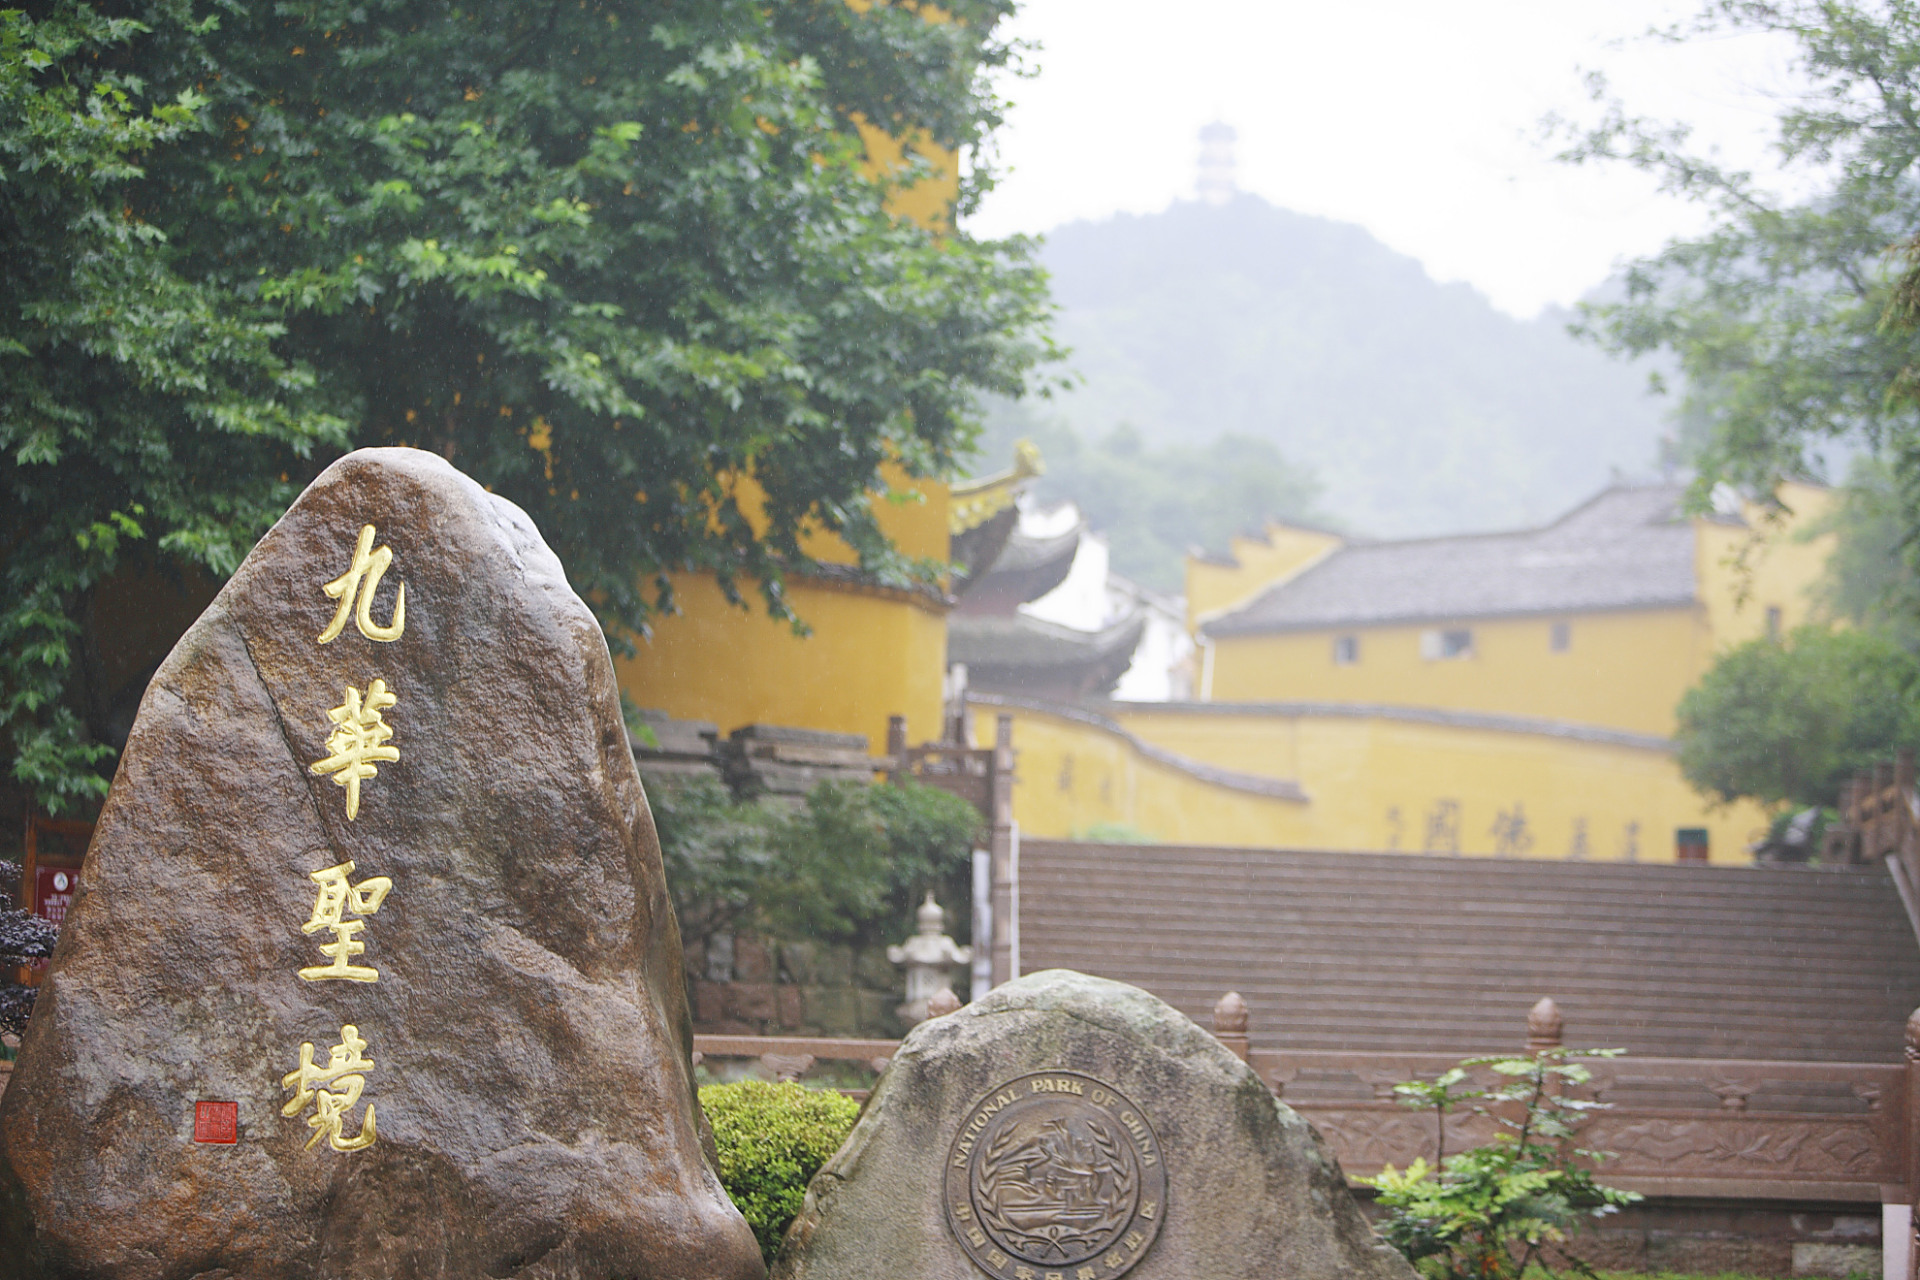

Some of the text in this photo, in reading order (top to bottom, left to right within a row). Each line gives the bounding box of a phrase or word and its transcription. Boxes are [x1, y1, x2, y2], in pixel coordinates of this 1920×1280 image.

[281, 524, 405, 1151] 九華聖境
[954, 1078, 1158, 1169] NATIONAL PARK OF CHINA
